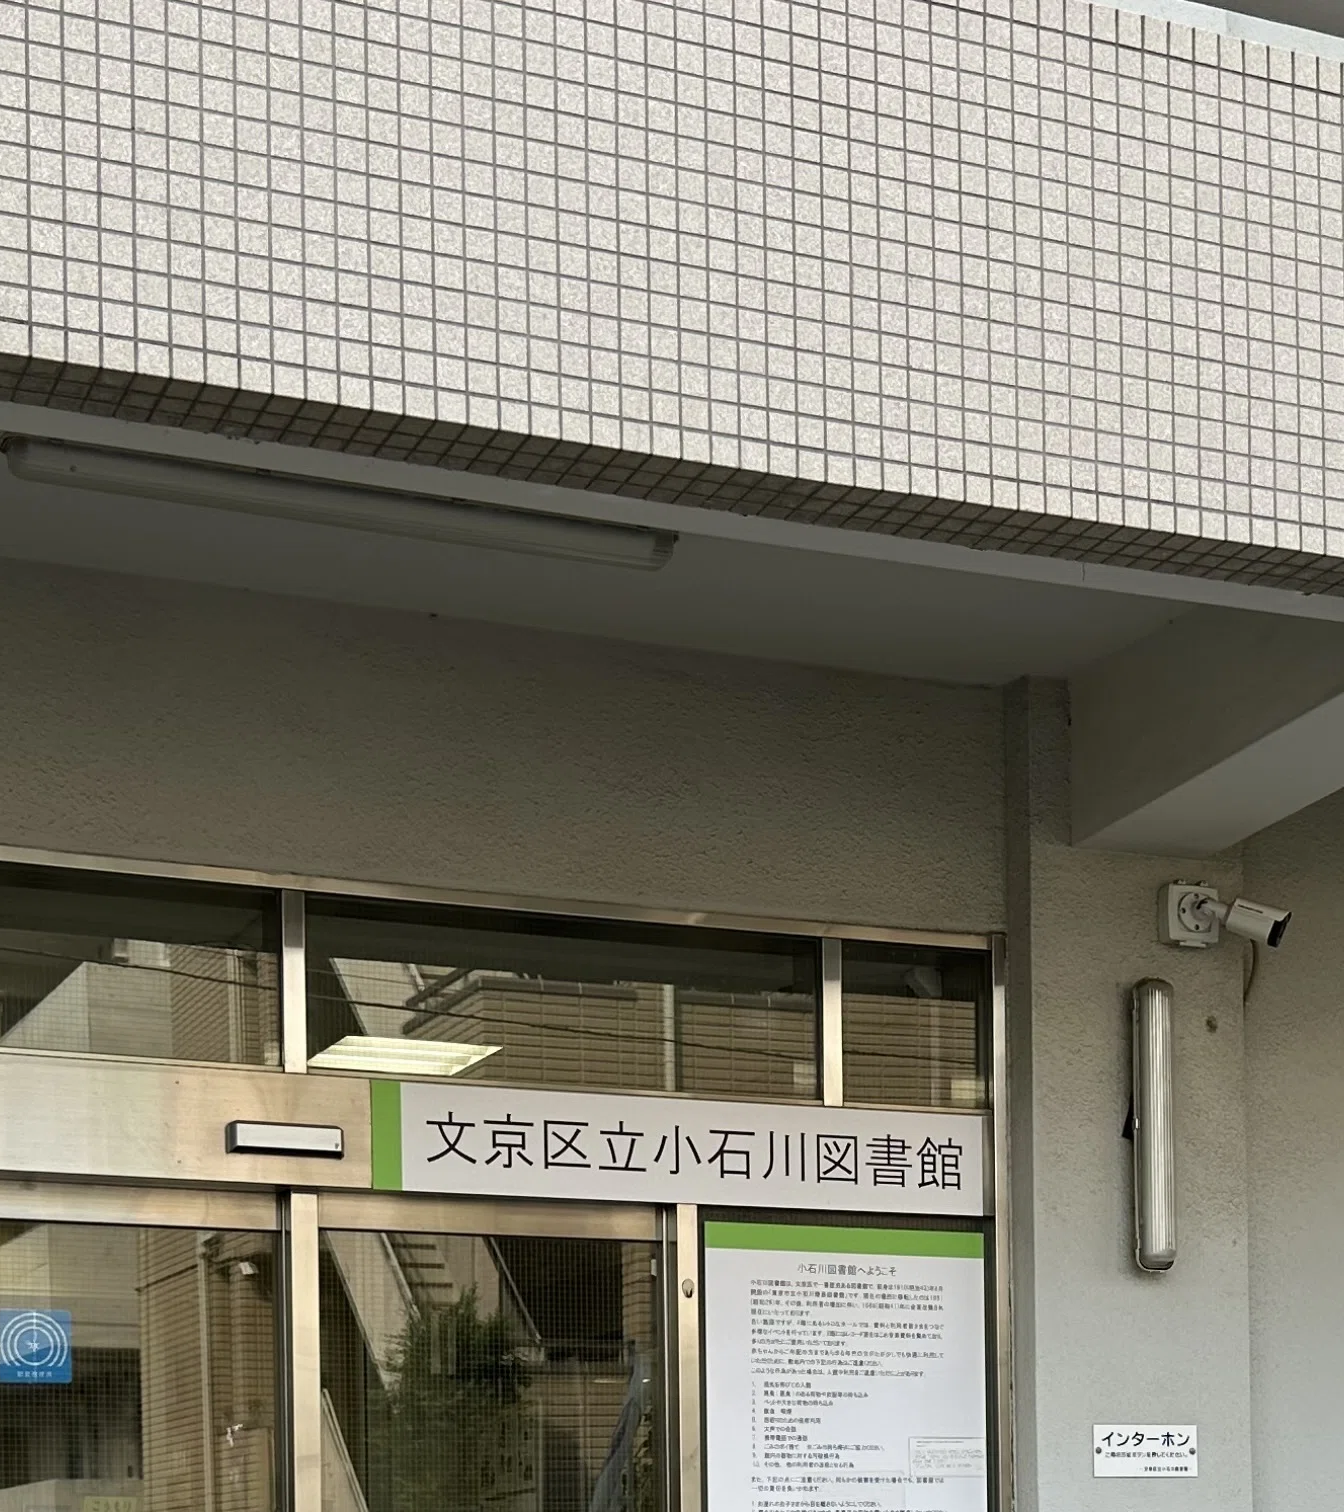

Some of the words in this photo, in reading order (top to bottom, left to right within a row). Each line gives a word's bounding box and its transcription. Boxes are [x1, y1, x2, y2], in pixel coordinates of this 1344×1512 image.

[425, 1111, 964, 1190] 文京区立小石川図書館
[798, 1263, 897, 1277] 小石川図書館へようこそ
[1102, 1432, 1190, 1447] インターホン
